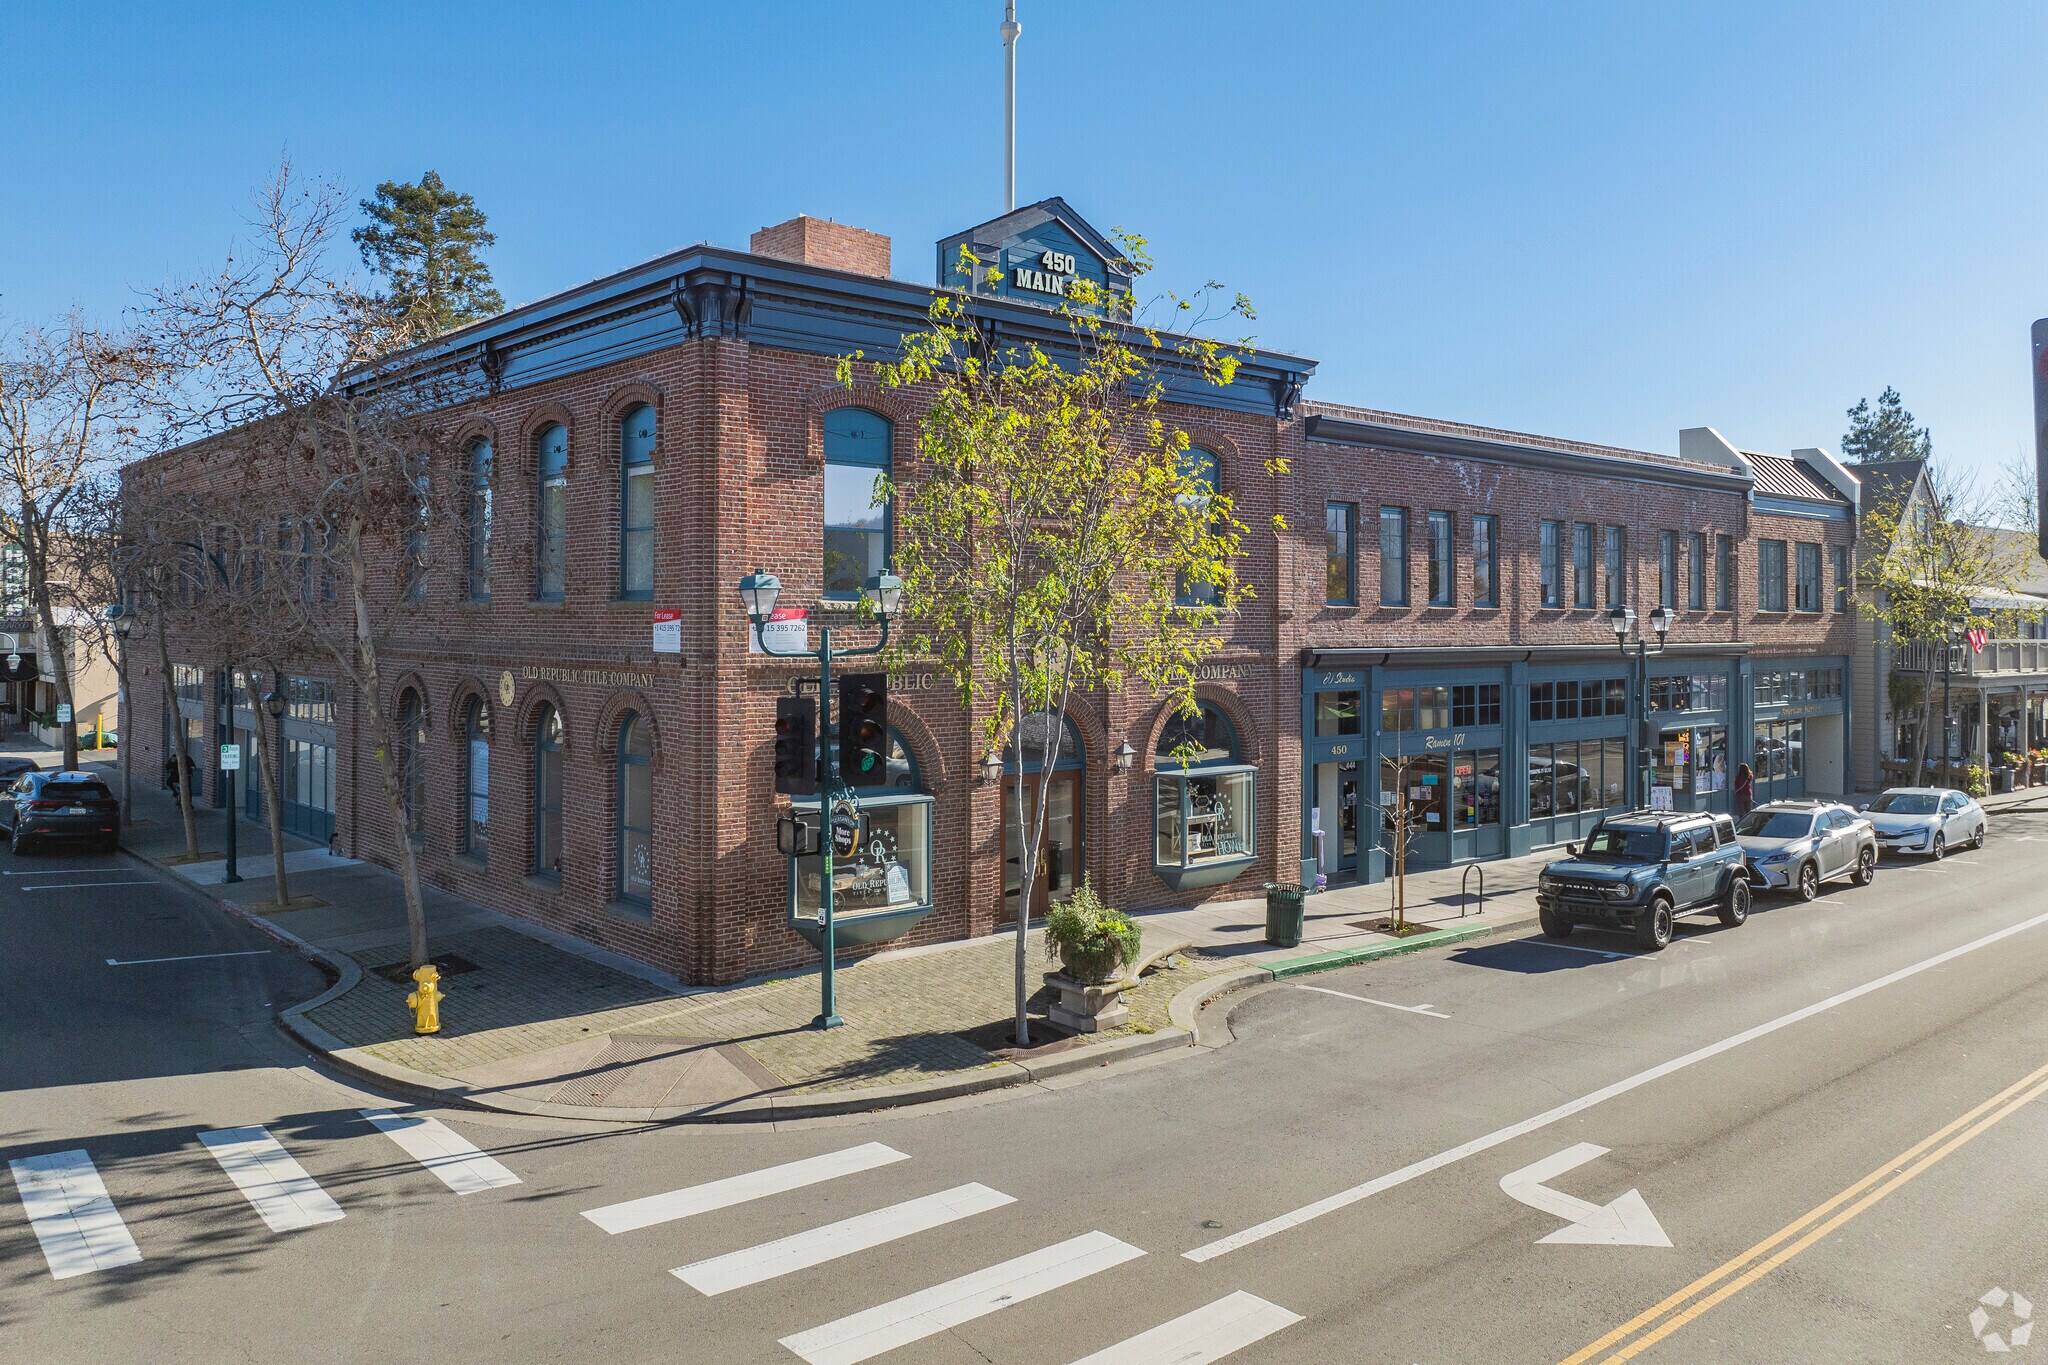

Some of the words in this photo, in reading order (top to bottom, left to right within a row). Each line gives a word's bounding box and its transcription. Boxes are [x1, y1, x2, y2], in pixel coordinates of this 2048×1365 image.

[1043, 250, 1075, 275] 450
[1016, 268, 1064, 295] MAIN
[522, 666, 539, 679] OLD
[540, 667, 581, 683] REPUBLIC
[583, 670, 608, 685] TITLE
[610, 671, 655, 688] COMPANY
[1193, 663, 1256, 680] COMPANY
[1334, 672, 1356, 684] Studio
[1425, 736, 1451, 749] Ramen
[1454, 733, 1465, 746] 101
[1331, 745, 1348, 755] 450
[1346, 761, 1356, 769] 444
[1455, 765, 1471, 776] OPEN
[836, 827, 850, 836] More
[835, 834, 852, 846] Shops
[853, 881, 868, 890] OLD
[870, 879, 888, 888] REPU
